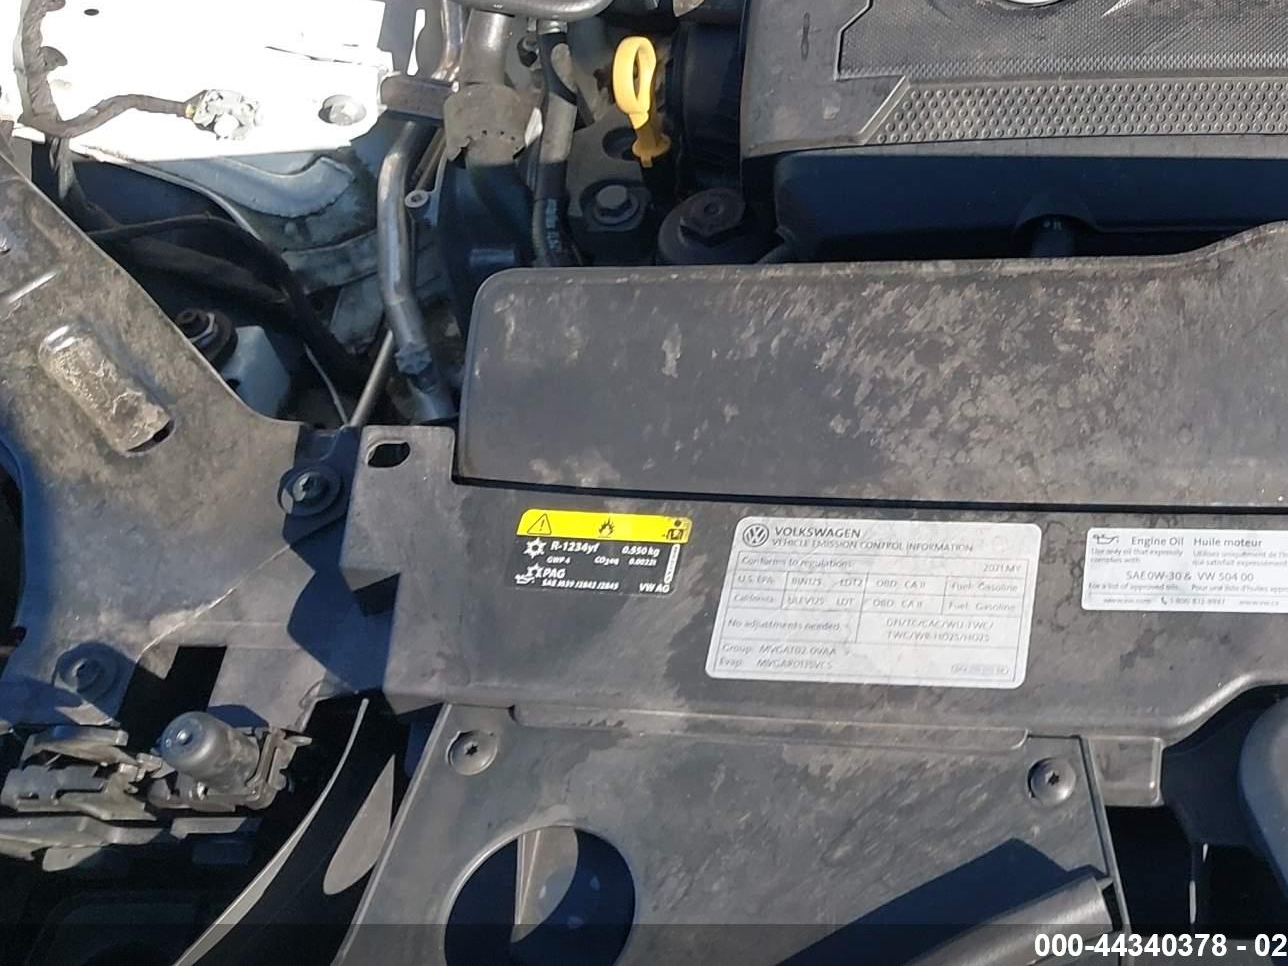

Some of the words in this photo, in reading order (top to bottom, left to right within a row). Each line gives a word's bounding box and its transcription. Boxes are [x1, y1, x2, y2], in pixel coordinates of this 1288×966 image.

[774, 526, 861, 538] VOLKSWAGEN
[550, 540, 600, 554] R-1234yf
[771, 537, 809, 547] VEHICLE
[811, 539, 858, 549] EMISSION
[859, 540, 904, 551] CONTROL
[905, 541, 974, 553] INFORMATION
[1131, 536, 1168, 548] Engine
[1169, 537, 1184, 546] Oil
[1193, 537, 1221, 547] Huile
[1223, 538, 1263, 547] moteur
[621, 545, 648, 555] 0.550
[647, 546, 660, 558] kg
[542, 567, 566, 579] PAG
[1126, 570, 1145, 580] SAE
[1147, 571, 1182, 581] 0W-30
[1183, 571, 1192, 581] &
[1197, 572, 1215, 581] VW
[1218, 572, 1238, 582] 504
[1240, 573, 1254, 582] 00
[639, 582, 656, 593] VW
[654, 584, 670, 594] AG
[977, 582, 1018, 593] Gasoline
[975, 602, 1016, 612] Gasoline
[727, 618, 743, 627] No
